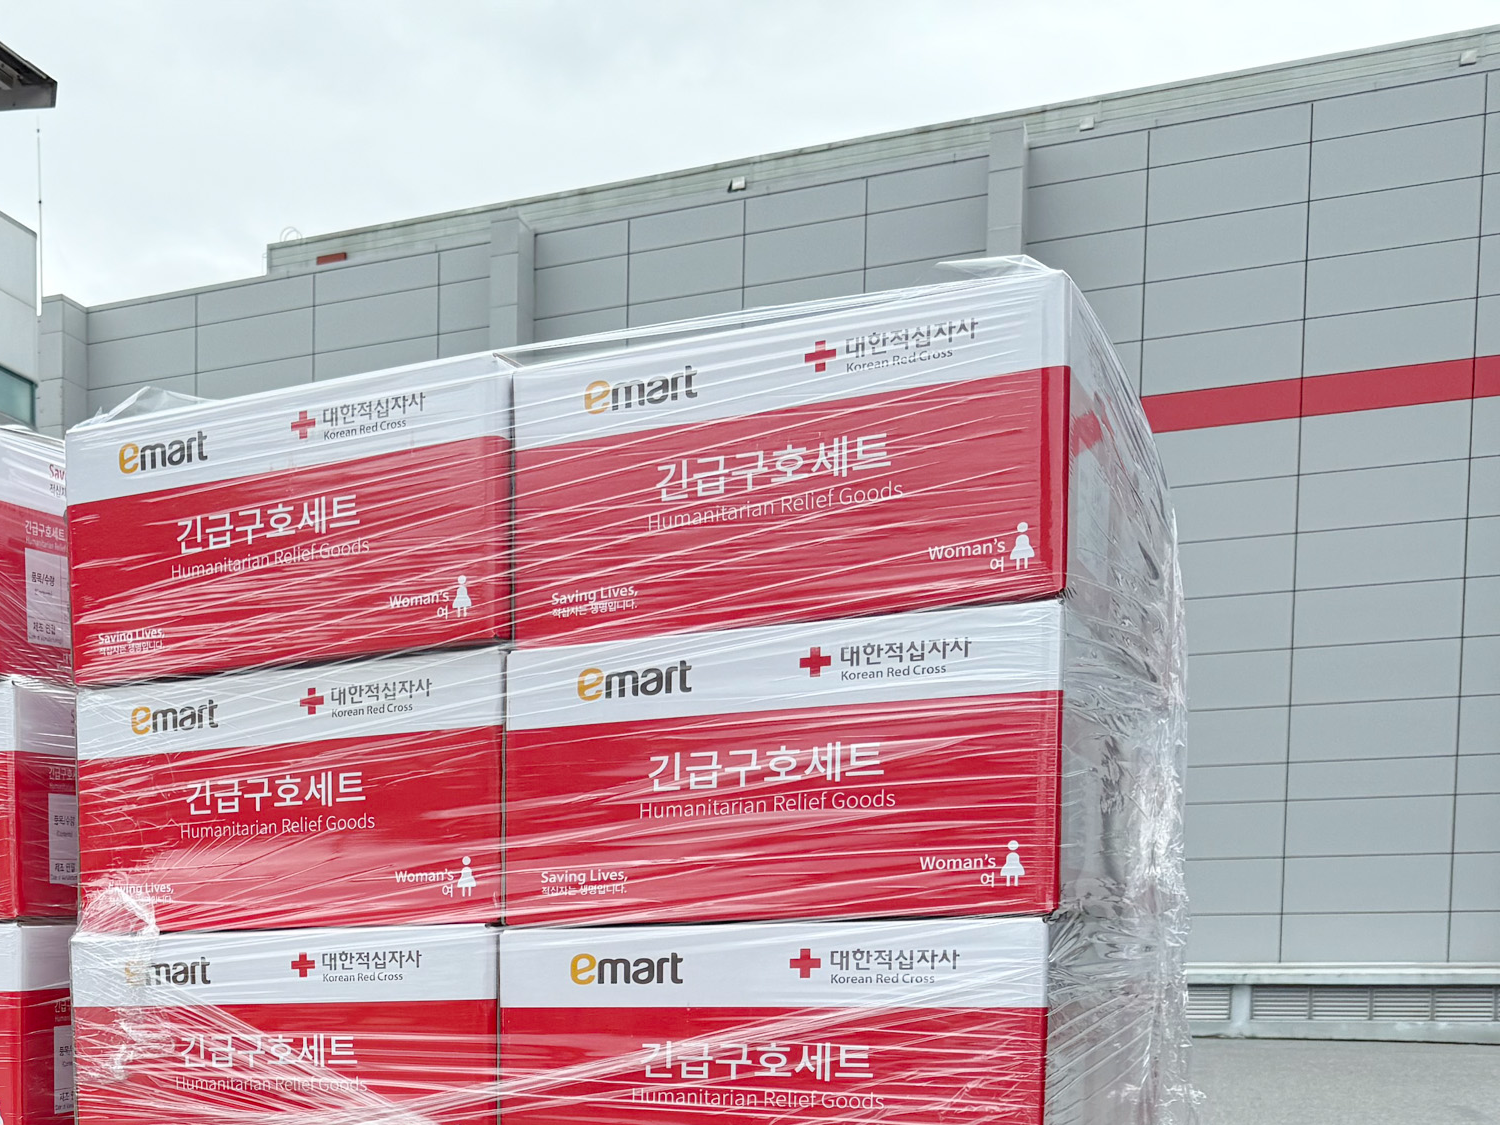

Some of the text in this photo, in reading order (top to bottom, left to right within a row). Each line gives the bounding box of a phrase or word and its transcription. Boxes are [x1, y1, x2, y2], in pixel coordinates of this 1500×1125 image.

[584, 365, 698, 415] emart
[322, 391, 426, 427] 대한적십자사
[118, 430, 209, 474] emart
[655, 432, 892, 503] 긴급구호세트
[176, 494, 361, 555] 긴급구호세트
[840, 636, 973, 667] 대한적십자사
[577, 660, 693, 701] emart
[841, 664, 948, 681] Korean Red Cross
[330, 678, 433, 706] 대한적십자사
[131, 699, 219, 735] emart
[331, 703, 414, 718] Korean Red Cross
[648, 741, 886, 792] 긴급구호세트
[186, 770, 367, 816] 긴급구호세트
[180, 812, 376, 840] Humanitarian Relief Goods
[322, 950, 422, 971] 대한적십자사
[570, 952, 684, 986] emart
[830, 949, 961, 971] 대한적십자사
[640, 1040, 875, 1082] 긴급구호세트
